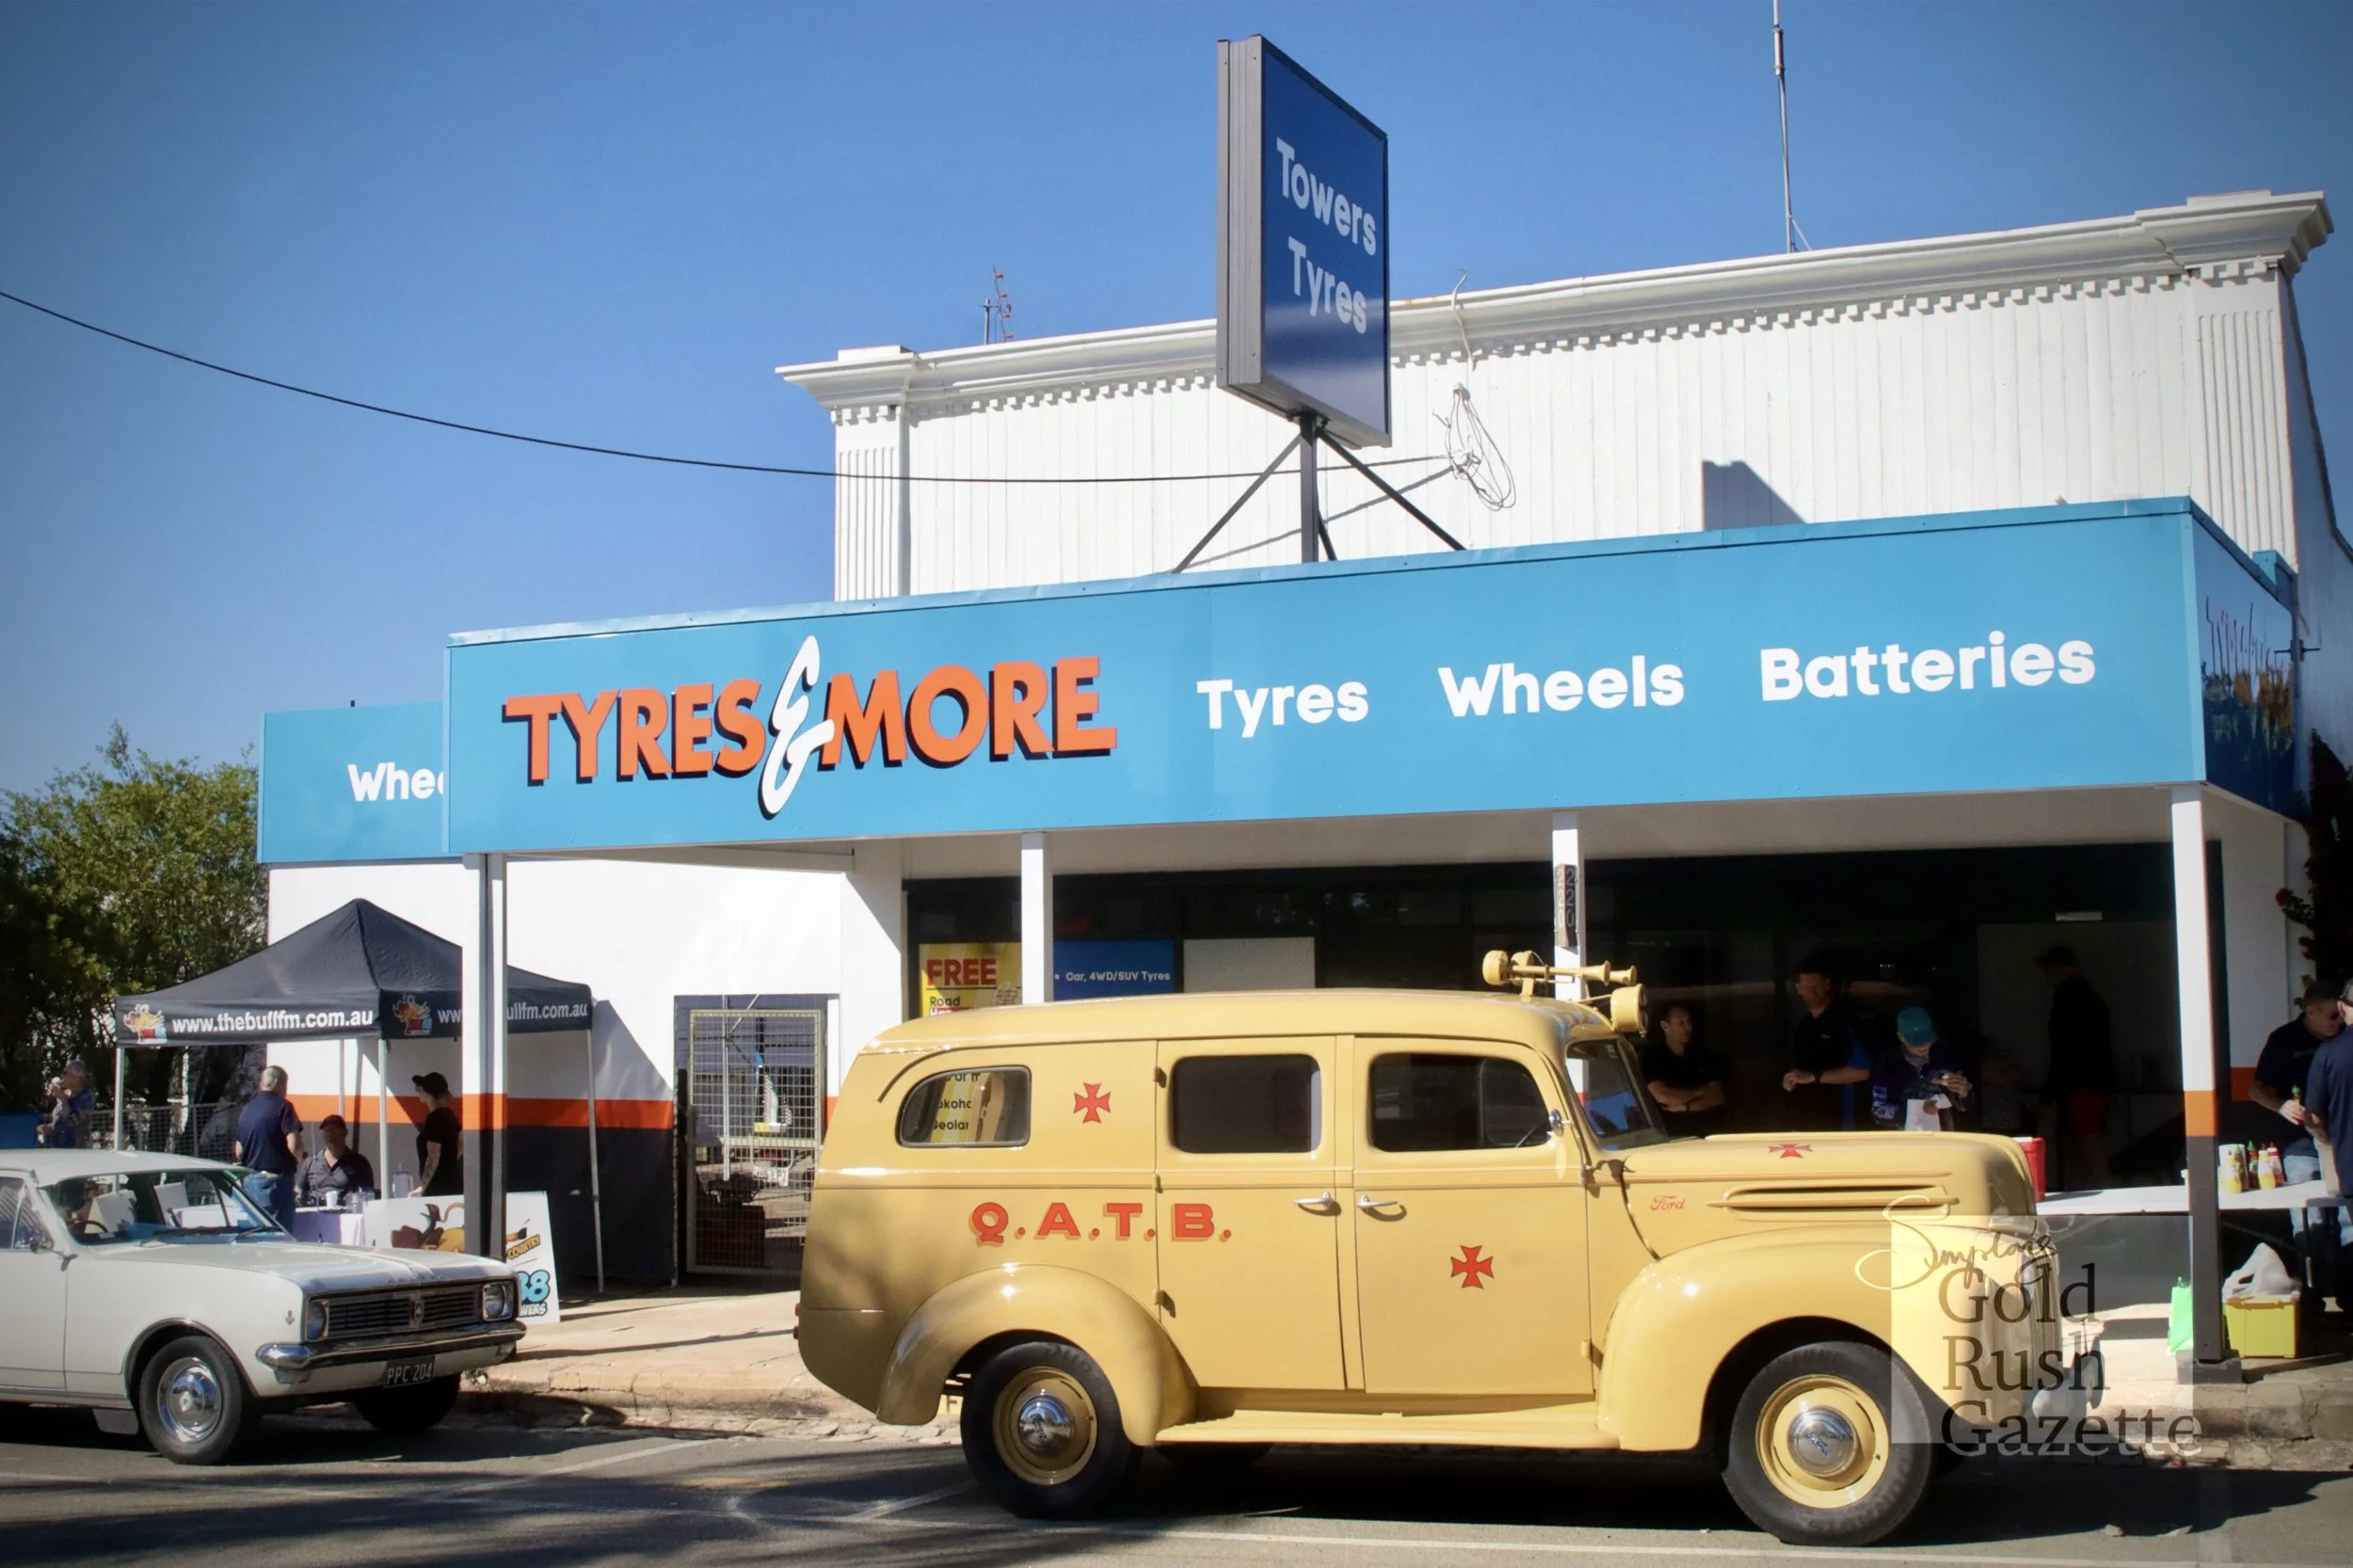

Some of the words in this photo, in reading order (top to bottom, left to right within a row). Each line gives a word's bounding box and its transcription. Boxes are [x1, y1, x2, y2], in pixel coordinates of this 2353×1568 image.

[1276, 136, 1376, 256] Towers
[1289, 235, 1367, 334] Tyres
[1196, 679, 1369, 738] Tyres
[1437, 655, 1685, 717] Wheels
[1760, 631, 2096, 701] Batteries
[502, 679, 766, 786] TYRES
[817, 656, 1117, 772] MORE
[926, 958, 997, 985] FREE
[1065, 971, 1087, 983] Car,
[1089, 971, 1139, 982] 4WD/SUV
[1141, 970, 1171, 983] Tyres
[930, 996, 961, 1007] Road
[172, 1010, 374, 1033] www.thebullfm.com.au
[1650, 1195, 1686, 1211] Ford
[968, 1202, 1231, 1247] Q.A.T.B.
[506, 1234, 541, 1260] COUNTRY
[387, 1366, 411, 1385] PPC
[412, 1363, 433, 1382] 204
